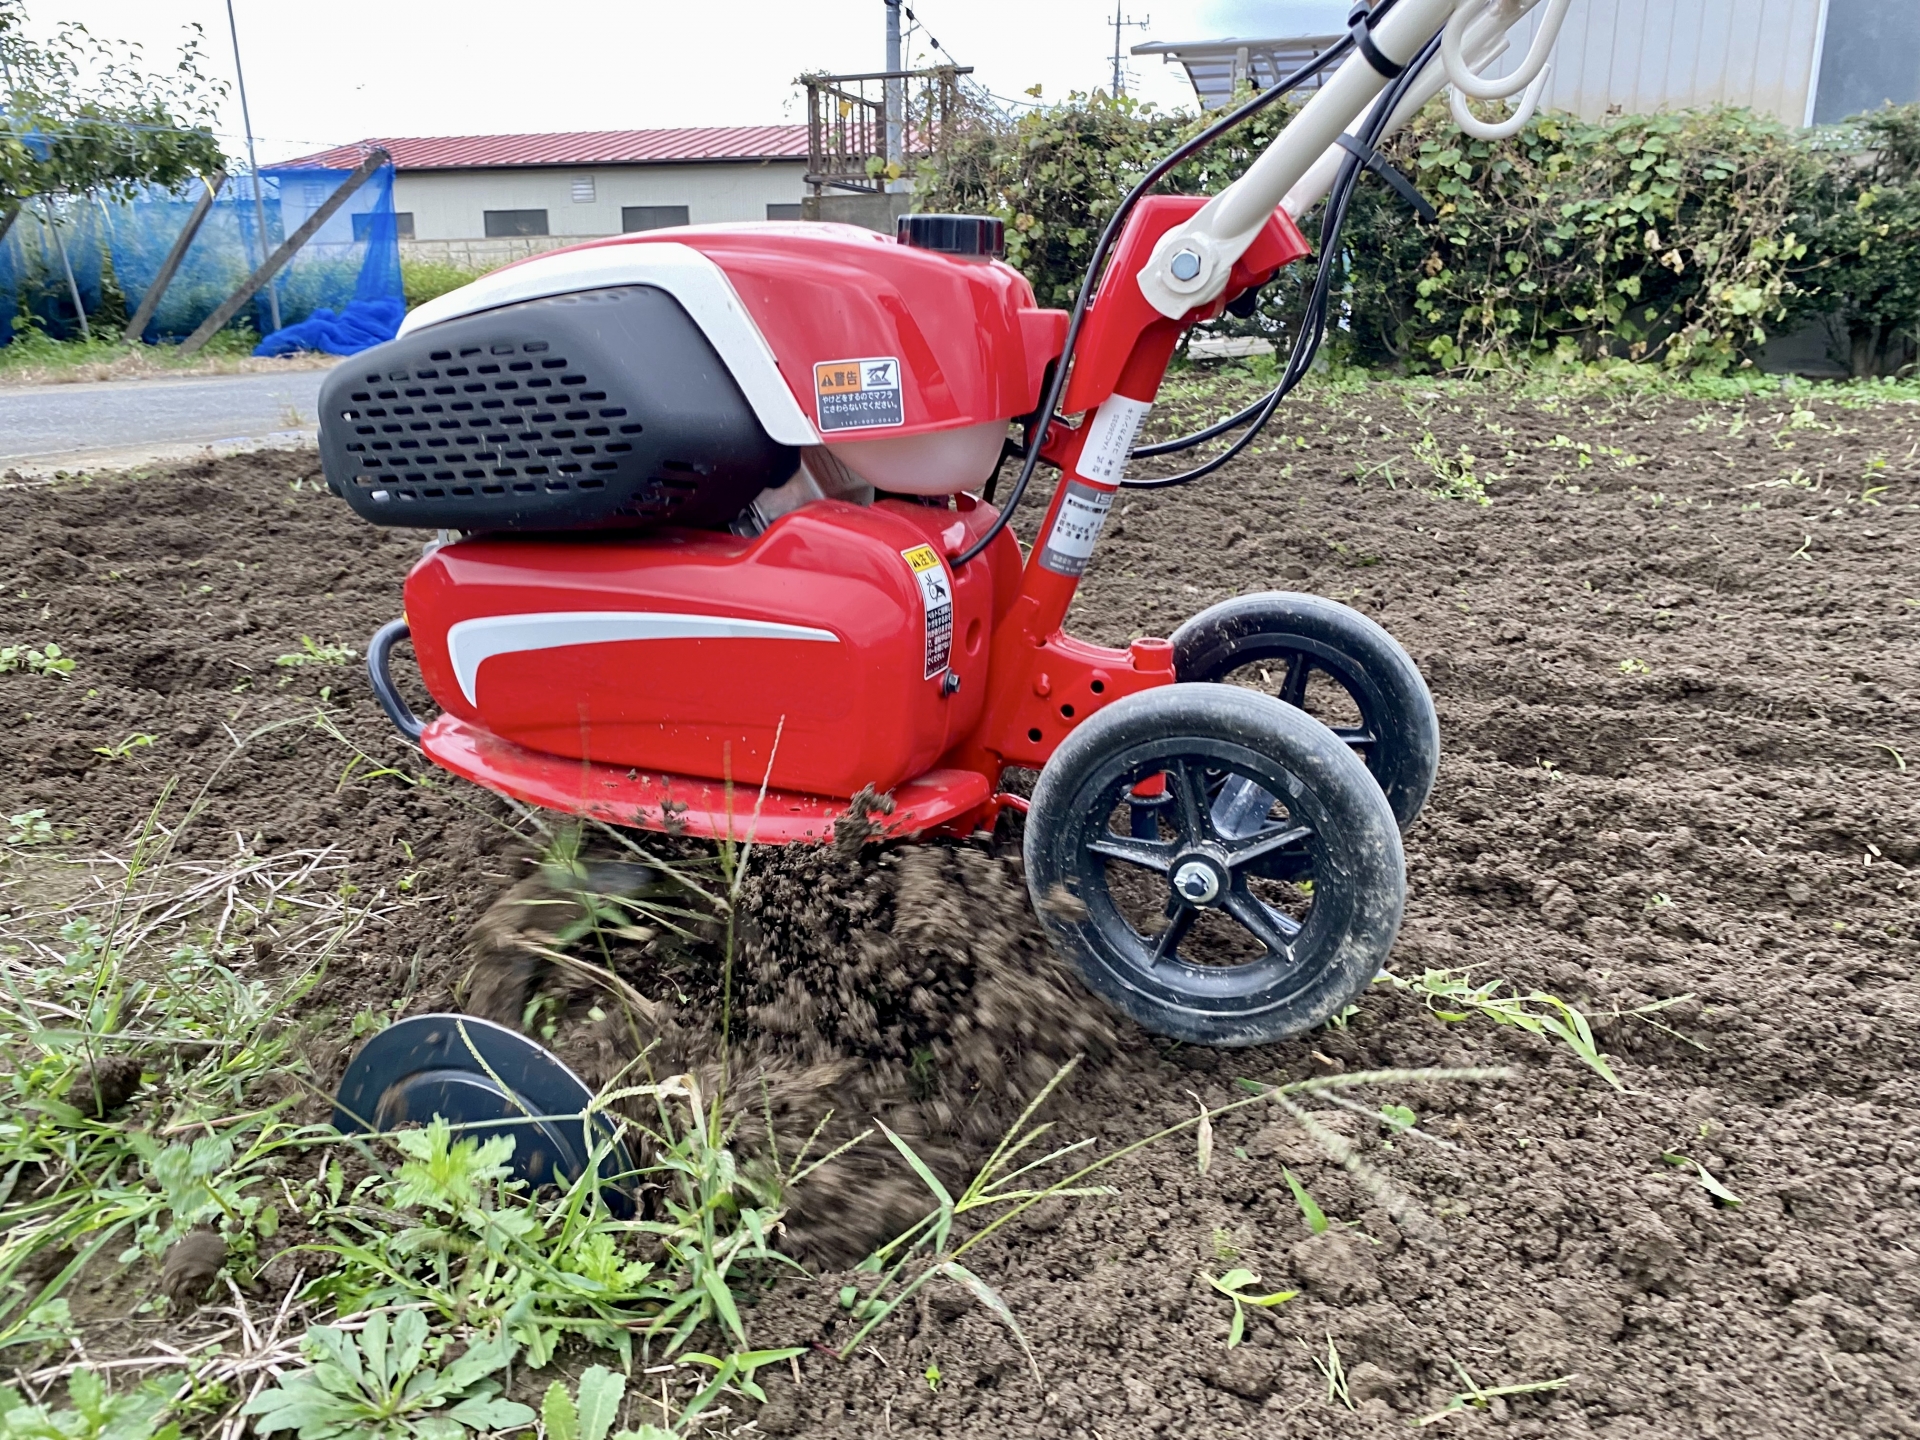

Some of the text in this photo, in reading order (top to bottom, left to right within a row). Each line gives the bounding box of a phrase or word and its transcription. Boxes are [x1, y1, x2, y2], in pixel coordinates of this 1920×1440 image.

[834, 371, 858, 387] 警告
[822, 390, 893, 404] やけどをするのでマフラ
[823, 400, 898, 414] にさわらないでください。
